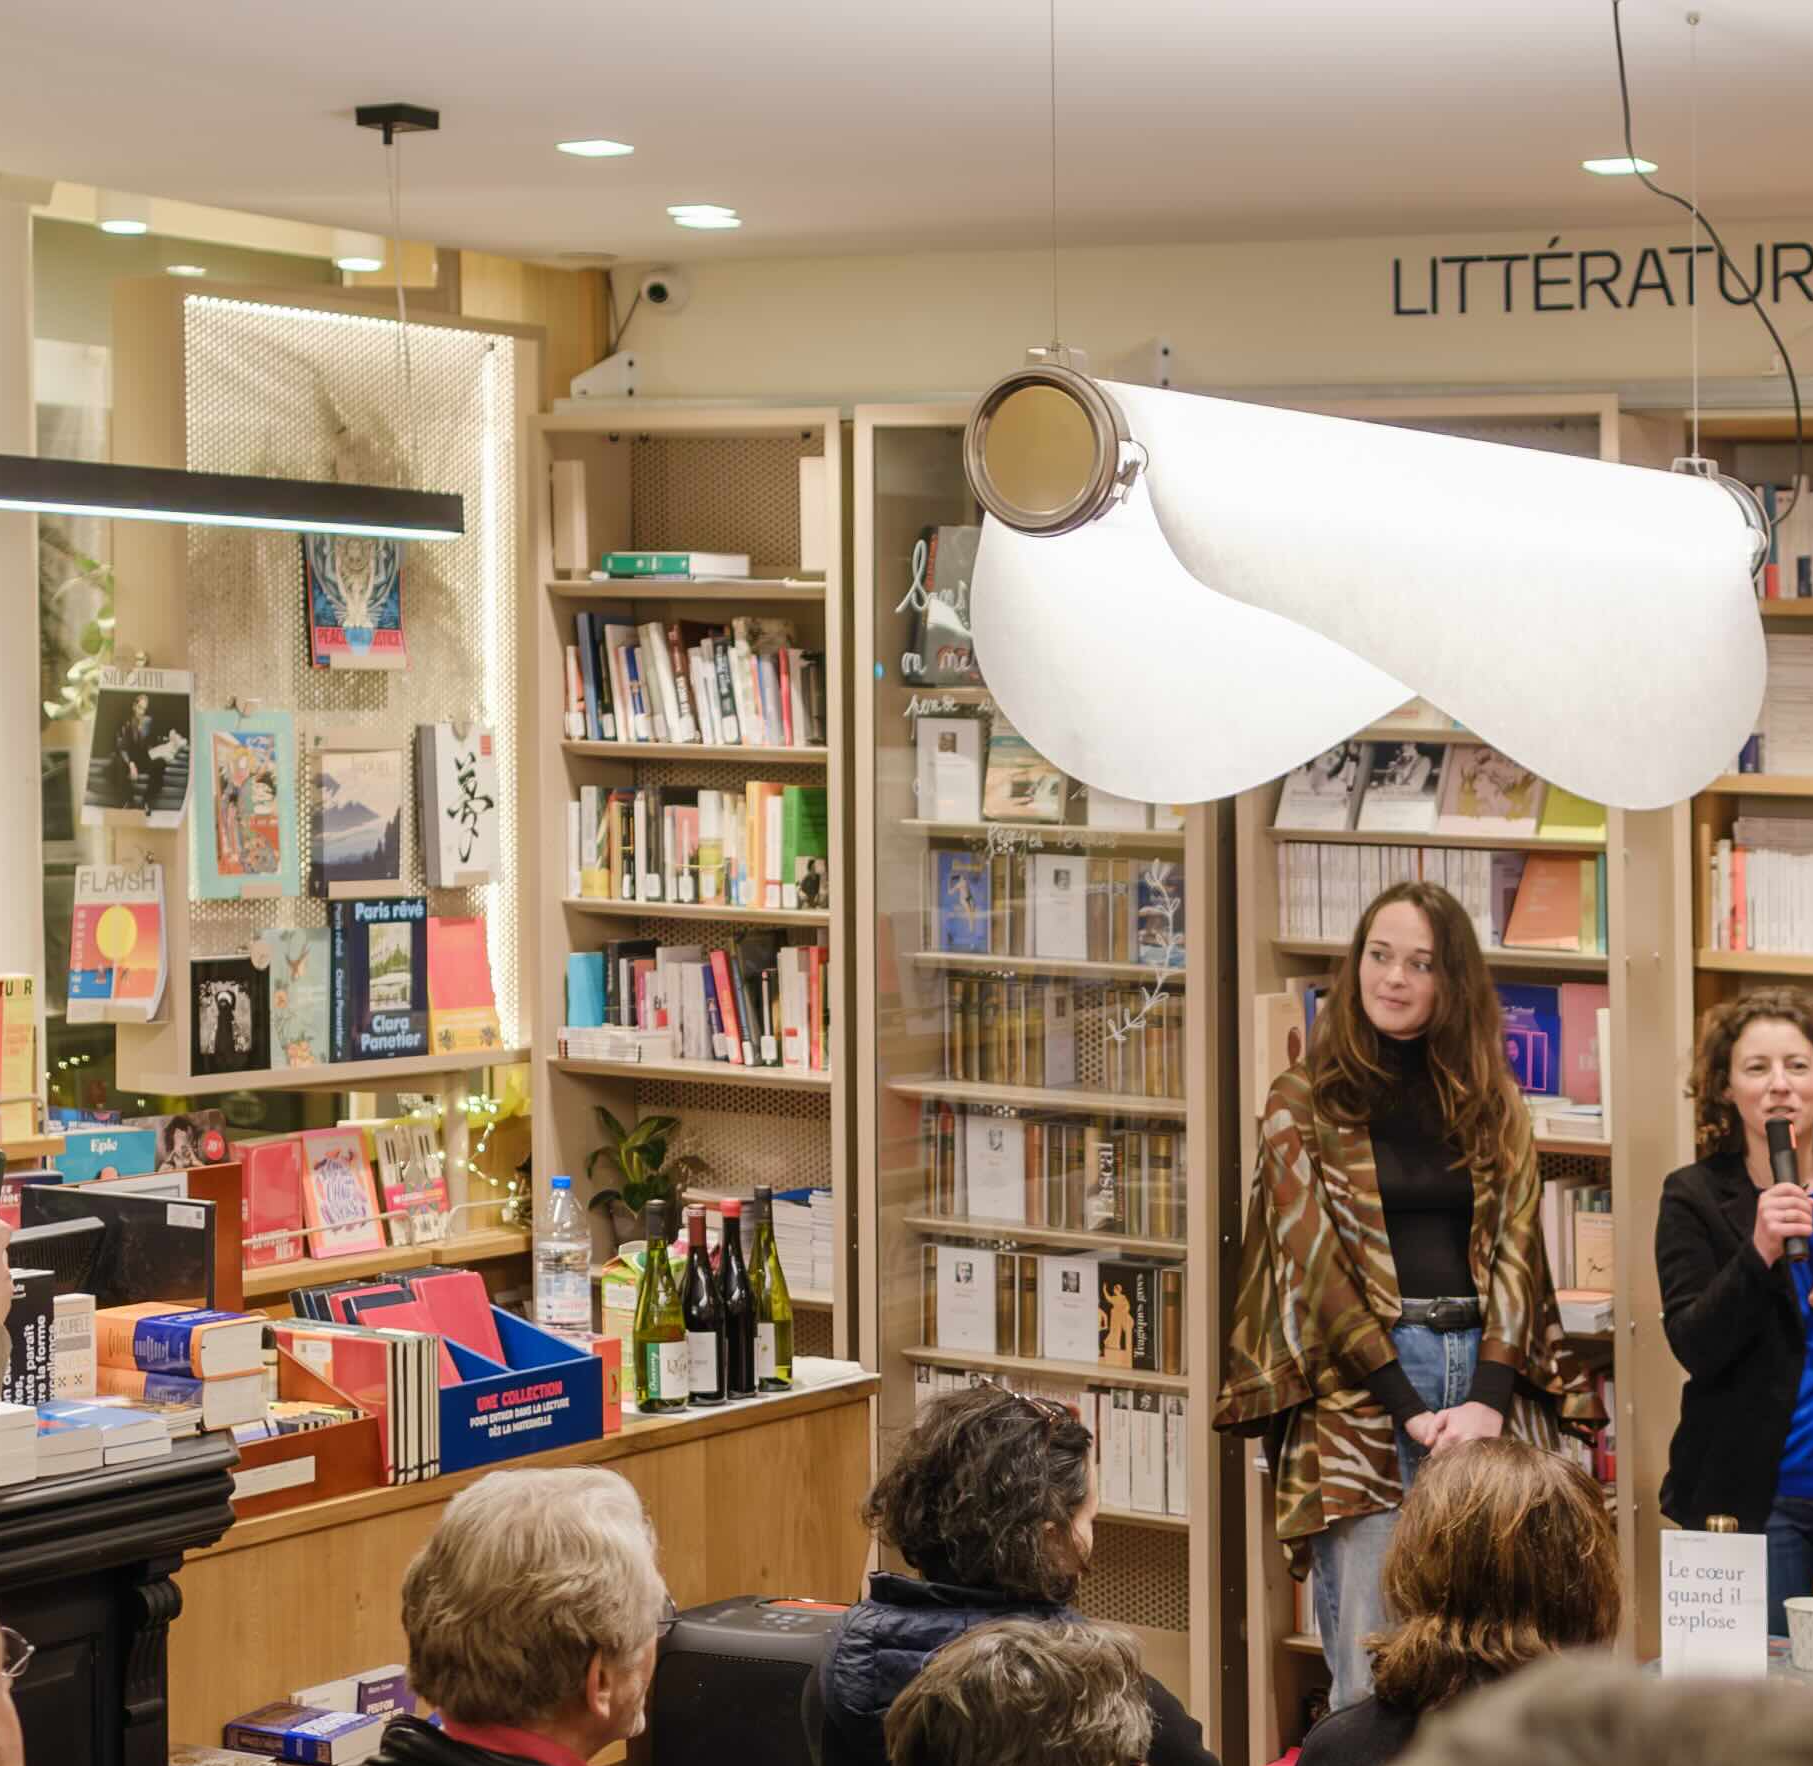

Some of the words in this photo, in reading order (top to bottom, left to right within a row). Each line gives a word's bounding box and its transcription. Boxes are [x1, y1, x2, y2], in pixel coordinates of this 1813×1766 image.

[355, 902, 390, 922] Paris
[392, 899, 425, 919] rêvé
[372, 1014, 410, 1033] Clara
[360, 1031, 421, 1053] Panetier
[23, 1323, 35, 1369] paraît
[36, 1314, 46, 1362] forme
[36, 1367, 46, 1384] la
[476, 1393, 498, 1412] UNE
[501, 1380, 563, 1407] COLLECTION
[470, 1415, 488, 1428] POUR
[515, 1405, 532, 1419] DANS
[533, 1402, 541, 1414] LA
[502, 1423, 512, 1435] LA
[1668, 1559, 1690, 1579] Le
[1695, 1566, 1745, 1581] cœur
[1667, 1587, 1723, 1607] quand
[1729, 1587, 1742, 1606] il
[1667, 1610, 1737, 1632] explose
